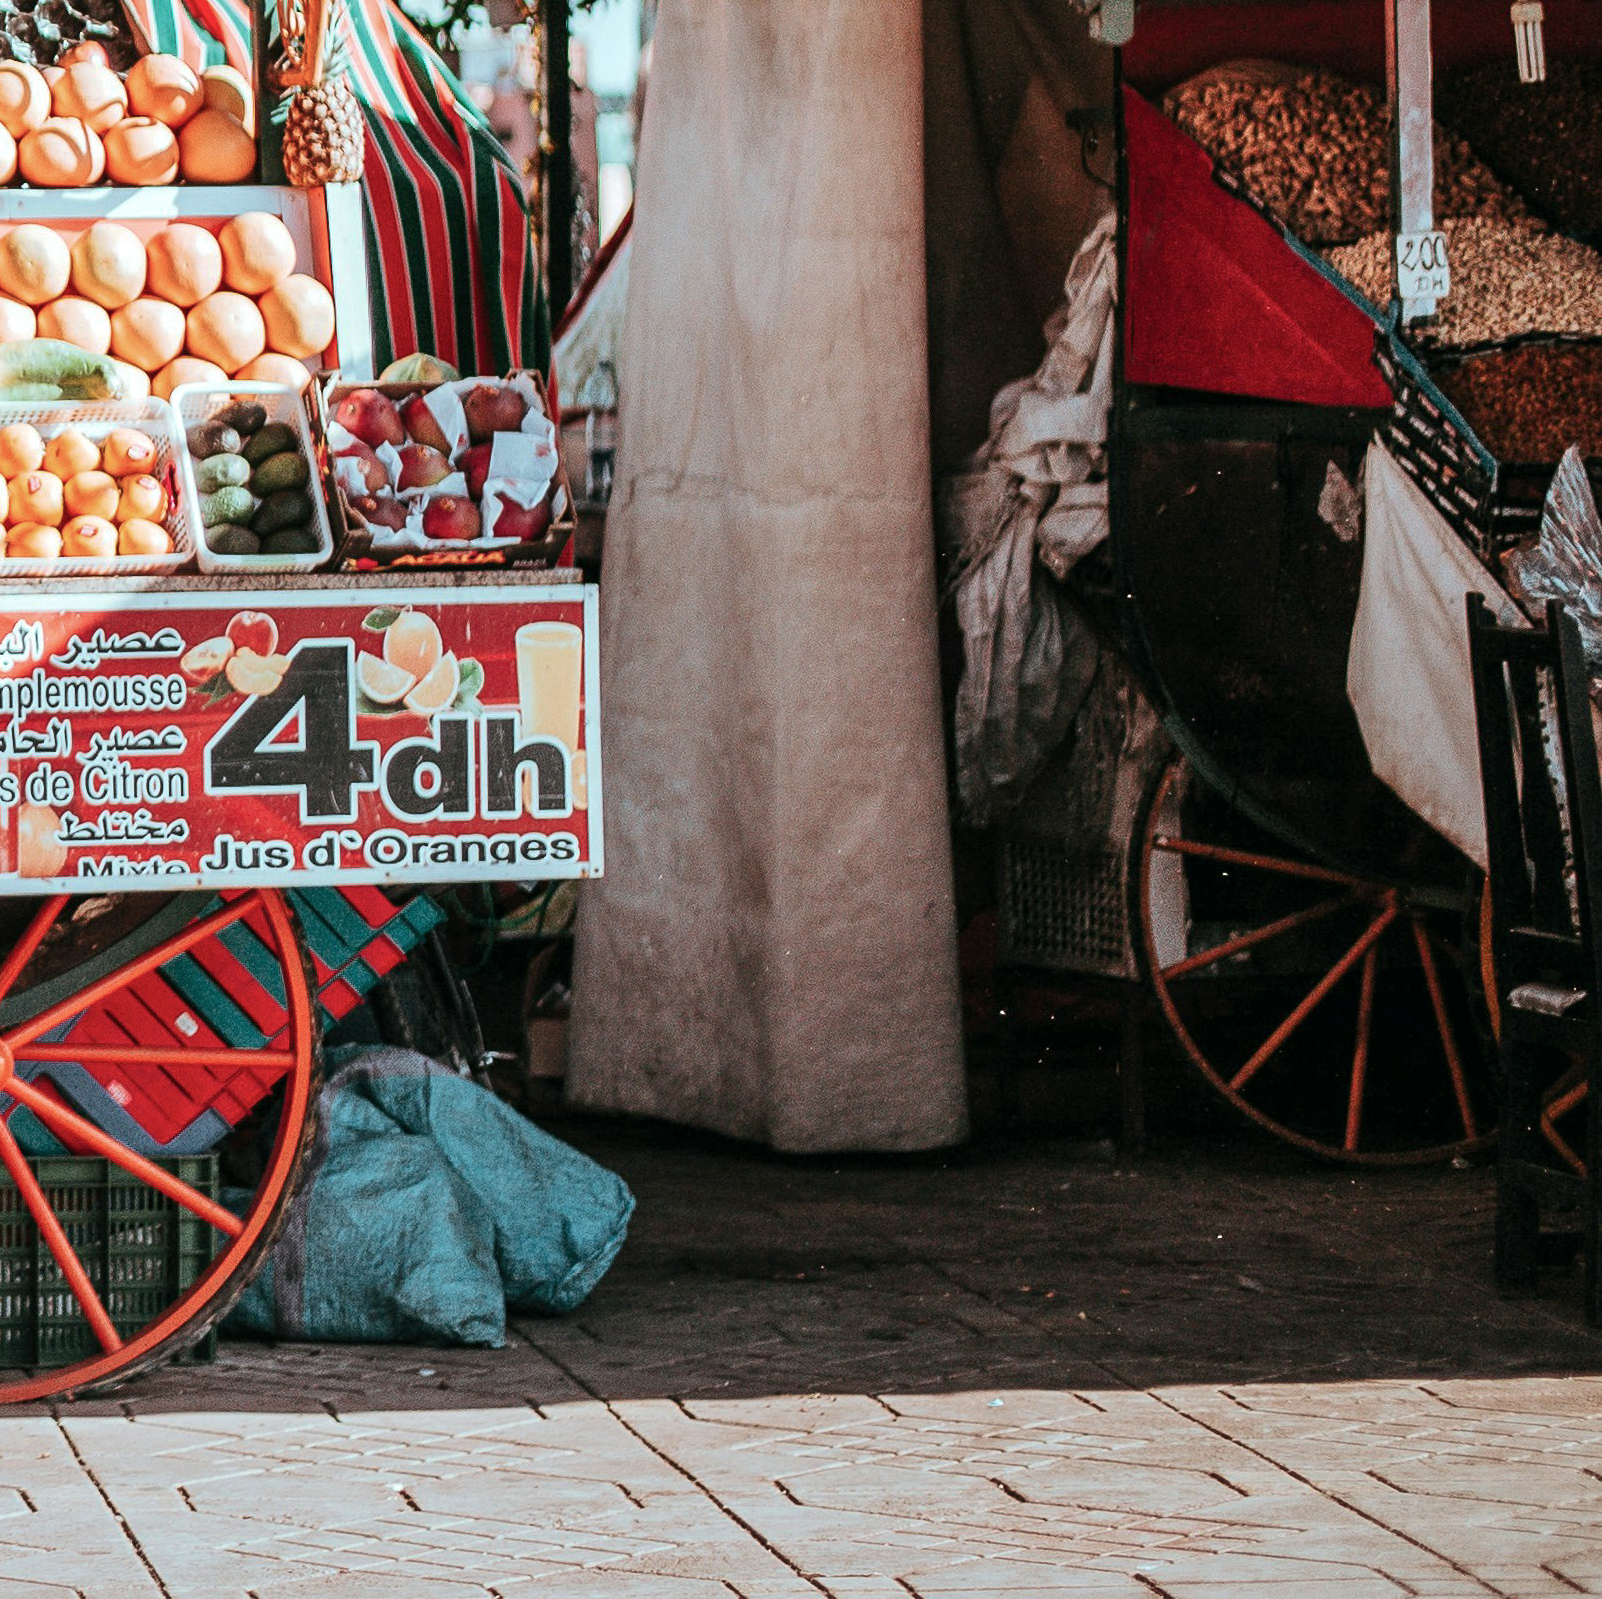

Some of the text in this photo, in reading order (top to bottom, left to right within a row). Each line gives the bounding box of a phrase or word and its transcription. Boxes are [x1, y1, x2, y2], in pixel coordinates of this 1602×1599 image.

[1401, 234, 1447, 271] 200
[51, 628, 183, 667] عصير
[78, 728, 184, 765] عصير
[29, 766, 71, 802] de
[83, 764, 186, 800] Citron
[58, 811, 186, 842] مختلط
[205, 839, 291, 871] Jus
